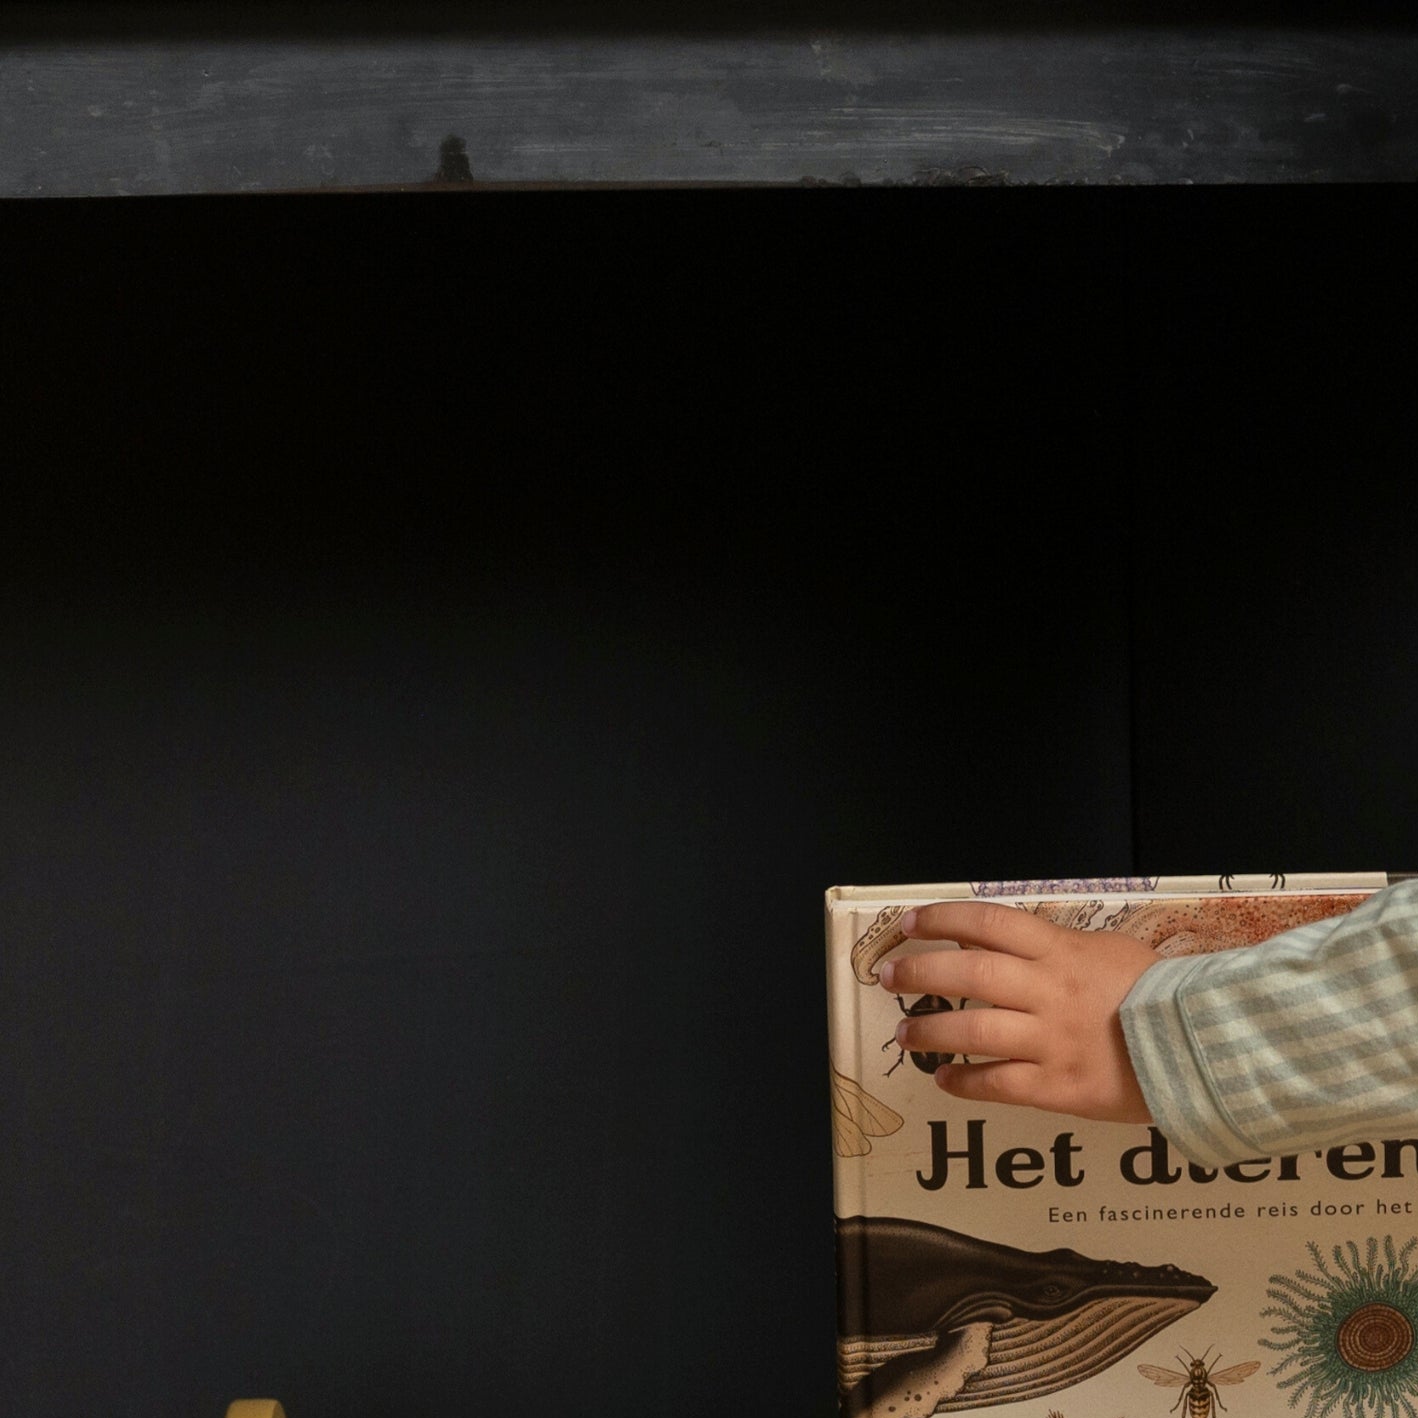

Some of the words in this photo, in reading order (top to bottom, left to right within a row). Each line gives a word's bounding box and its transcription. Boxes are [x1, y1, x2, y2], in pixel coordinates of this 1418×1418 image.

[915, 1119, 1085, 1191] Het
[1048, 1206, 1088, 1223] Een
[1099, 1202, 1246, 1222] fascinerende
[1257, 1202, 1298, 1218] reis
[1310, 1200, 1365, 1217] door
[1376, 1198, 1413, 1215] het
